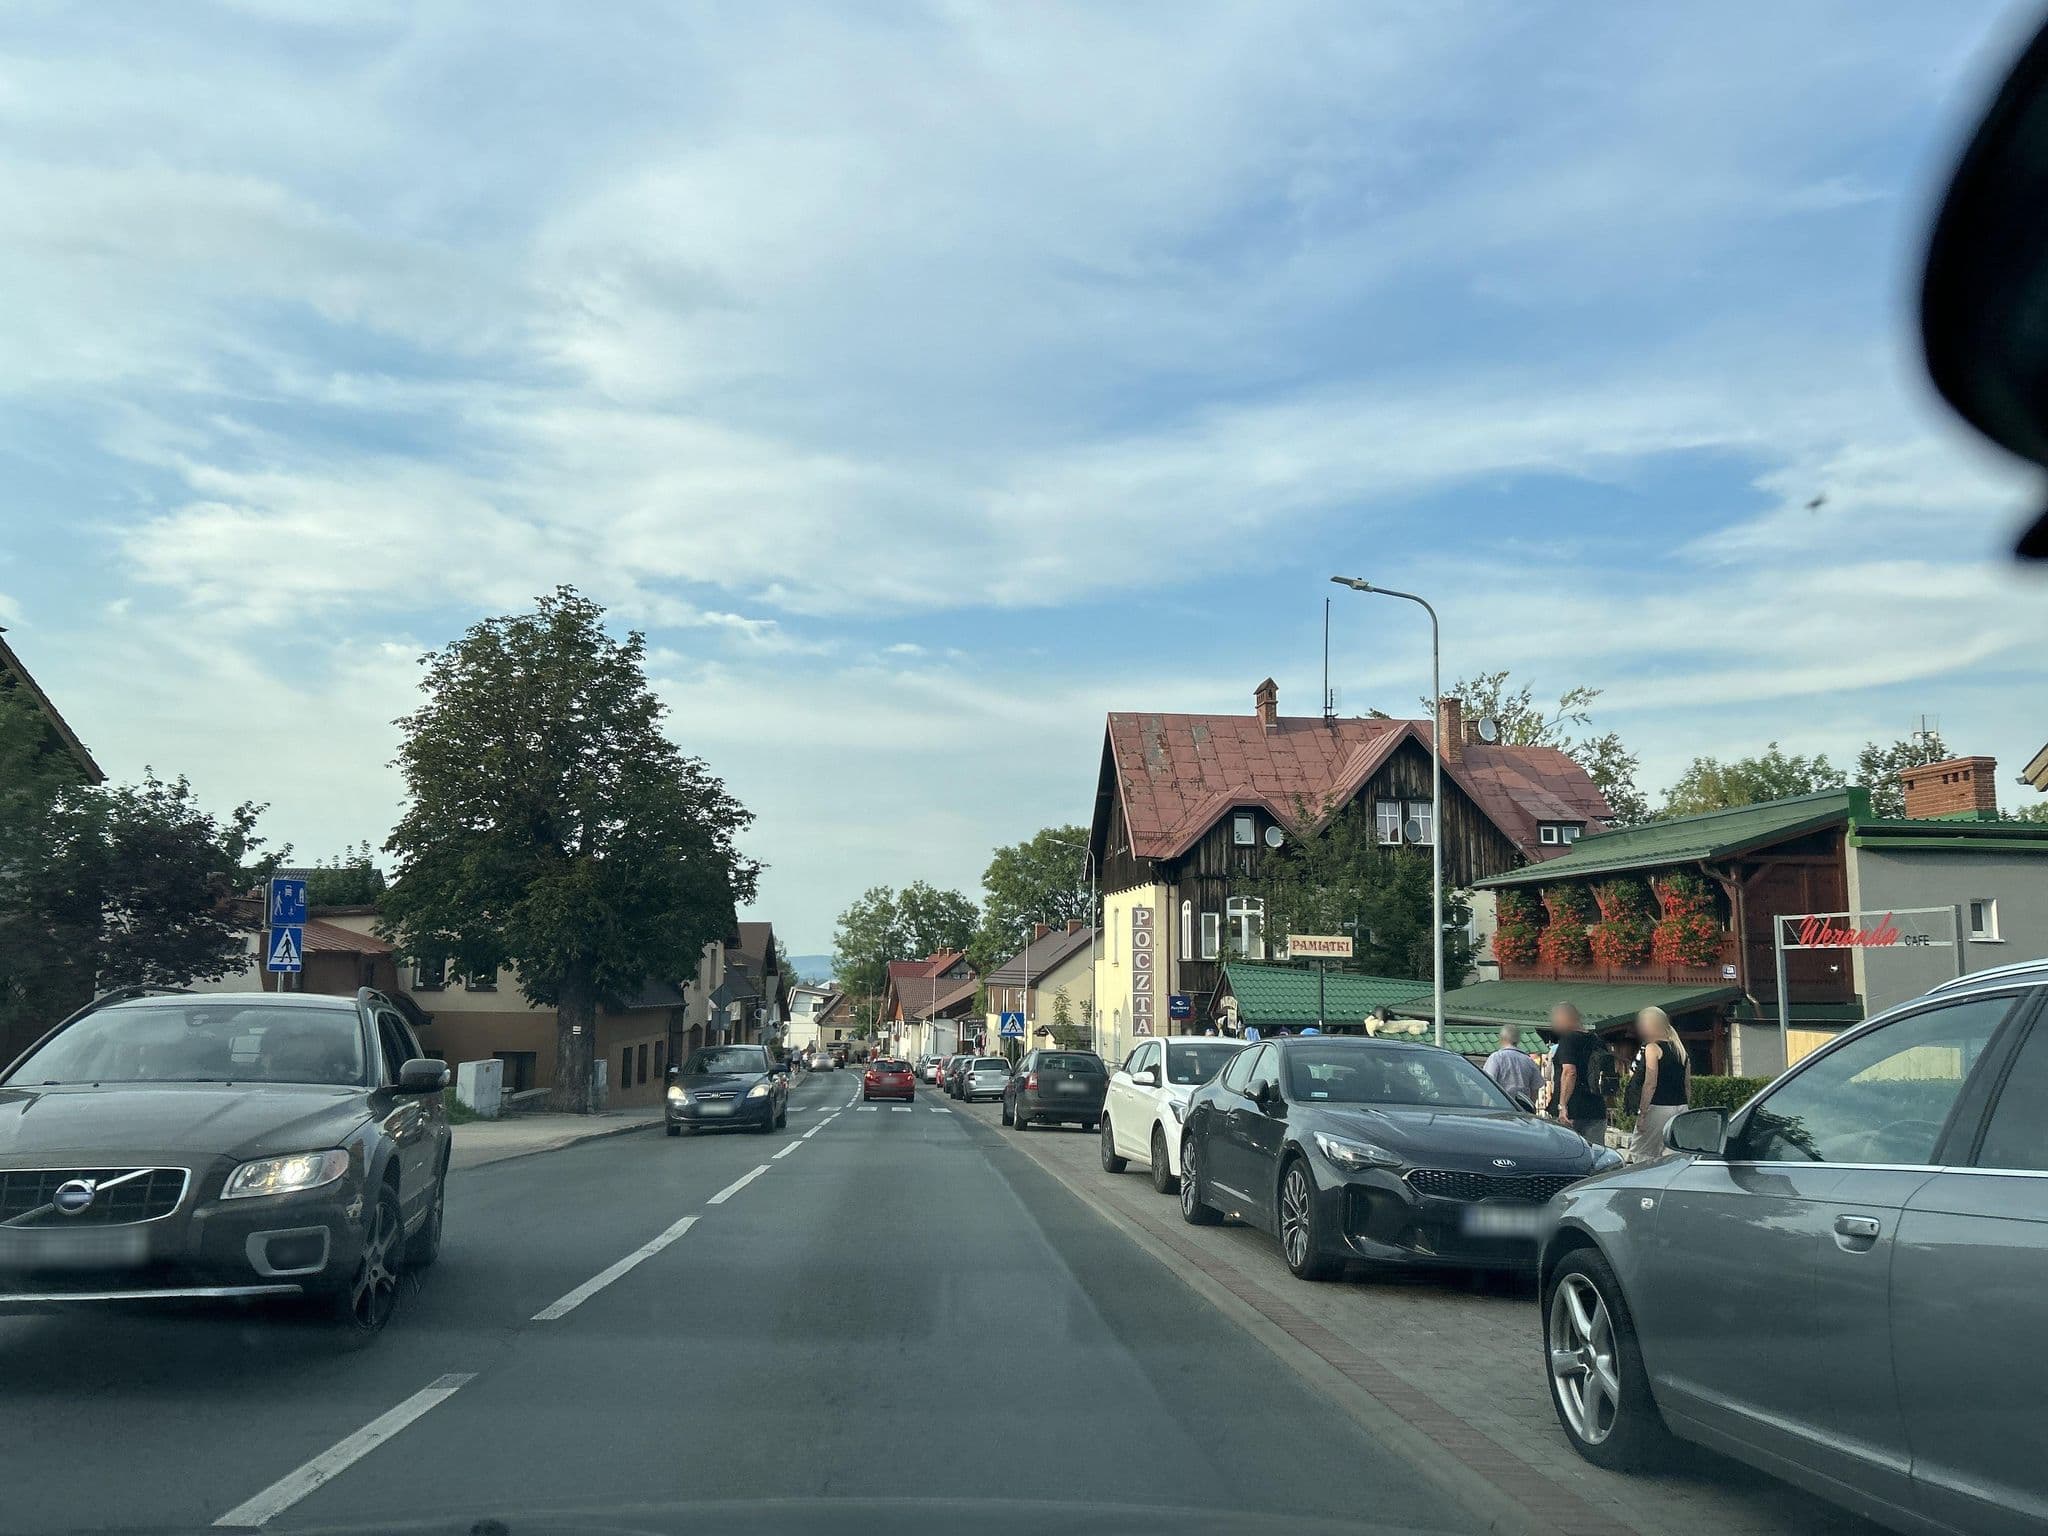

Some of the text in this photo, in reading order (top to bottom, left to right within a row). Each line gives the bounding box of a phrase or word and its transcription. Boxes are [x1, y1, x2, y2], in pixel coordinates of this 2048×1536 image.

[1799, 911, 1930, 948] Weranda CAFE
[1292, 940, 1350, 953] PAMIĄTKI
[1135, 910, 1151, 1035] POCZTA
[1494, 1159, 1515, 1167] KIA
